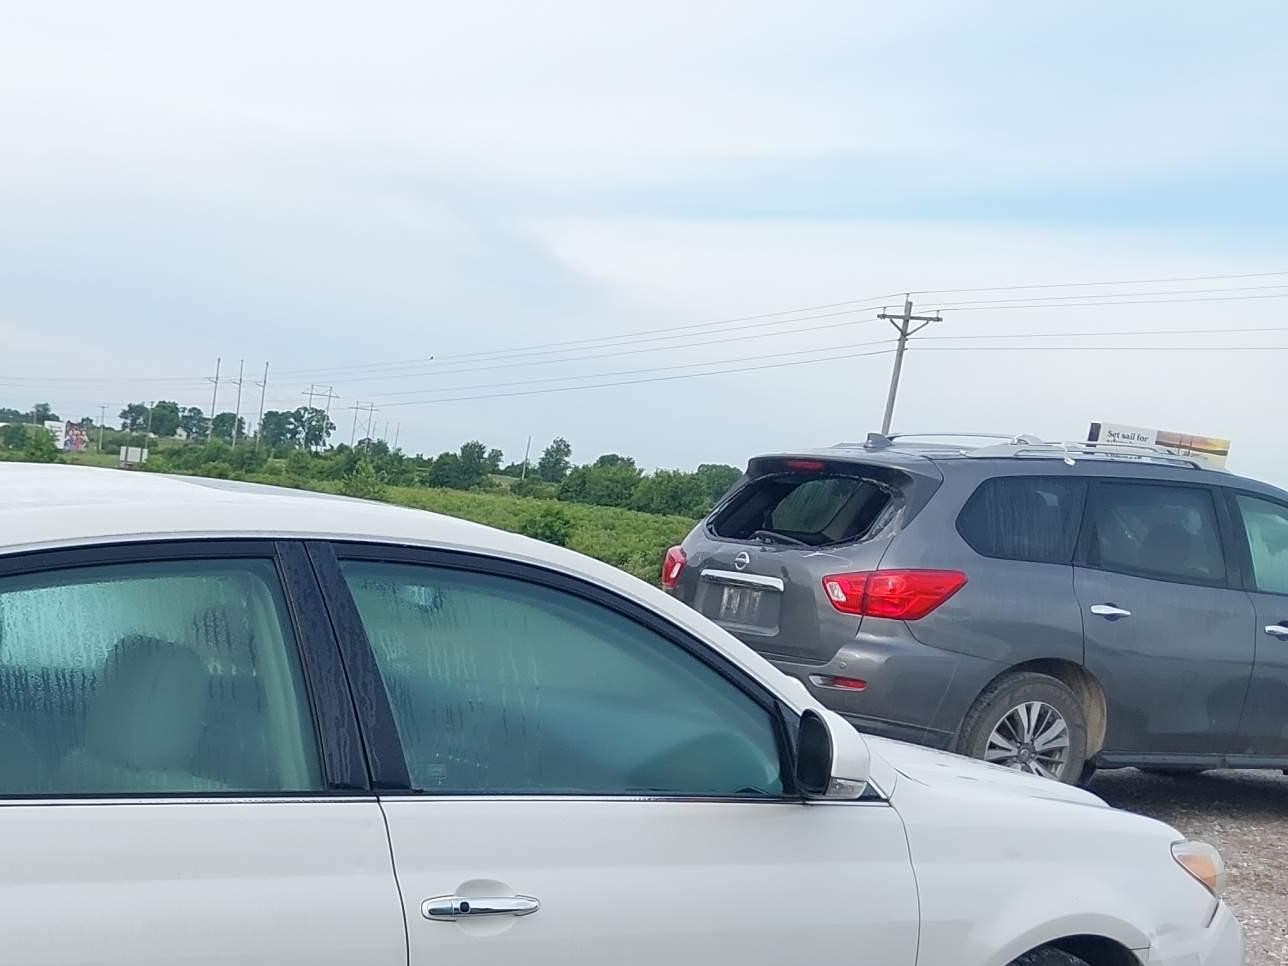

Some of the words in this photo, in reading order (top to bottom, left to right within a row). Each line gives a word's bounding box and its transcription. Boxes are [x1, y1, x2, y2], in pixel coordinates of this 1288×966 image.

[1107, 430, 1120, 438] Set
[1121, 432, 1136, 441] sail
[1136, 433, 1149, 442] for
